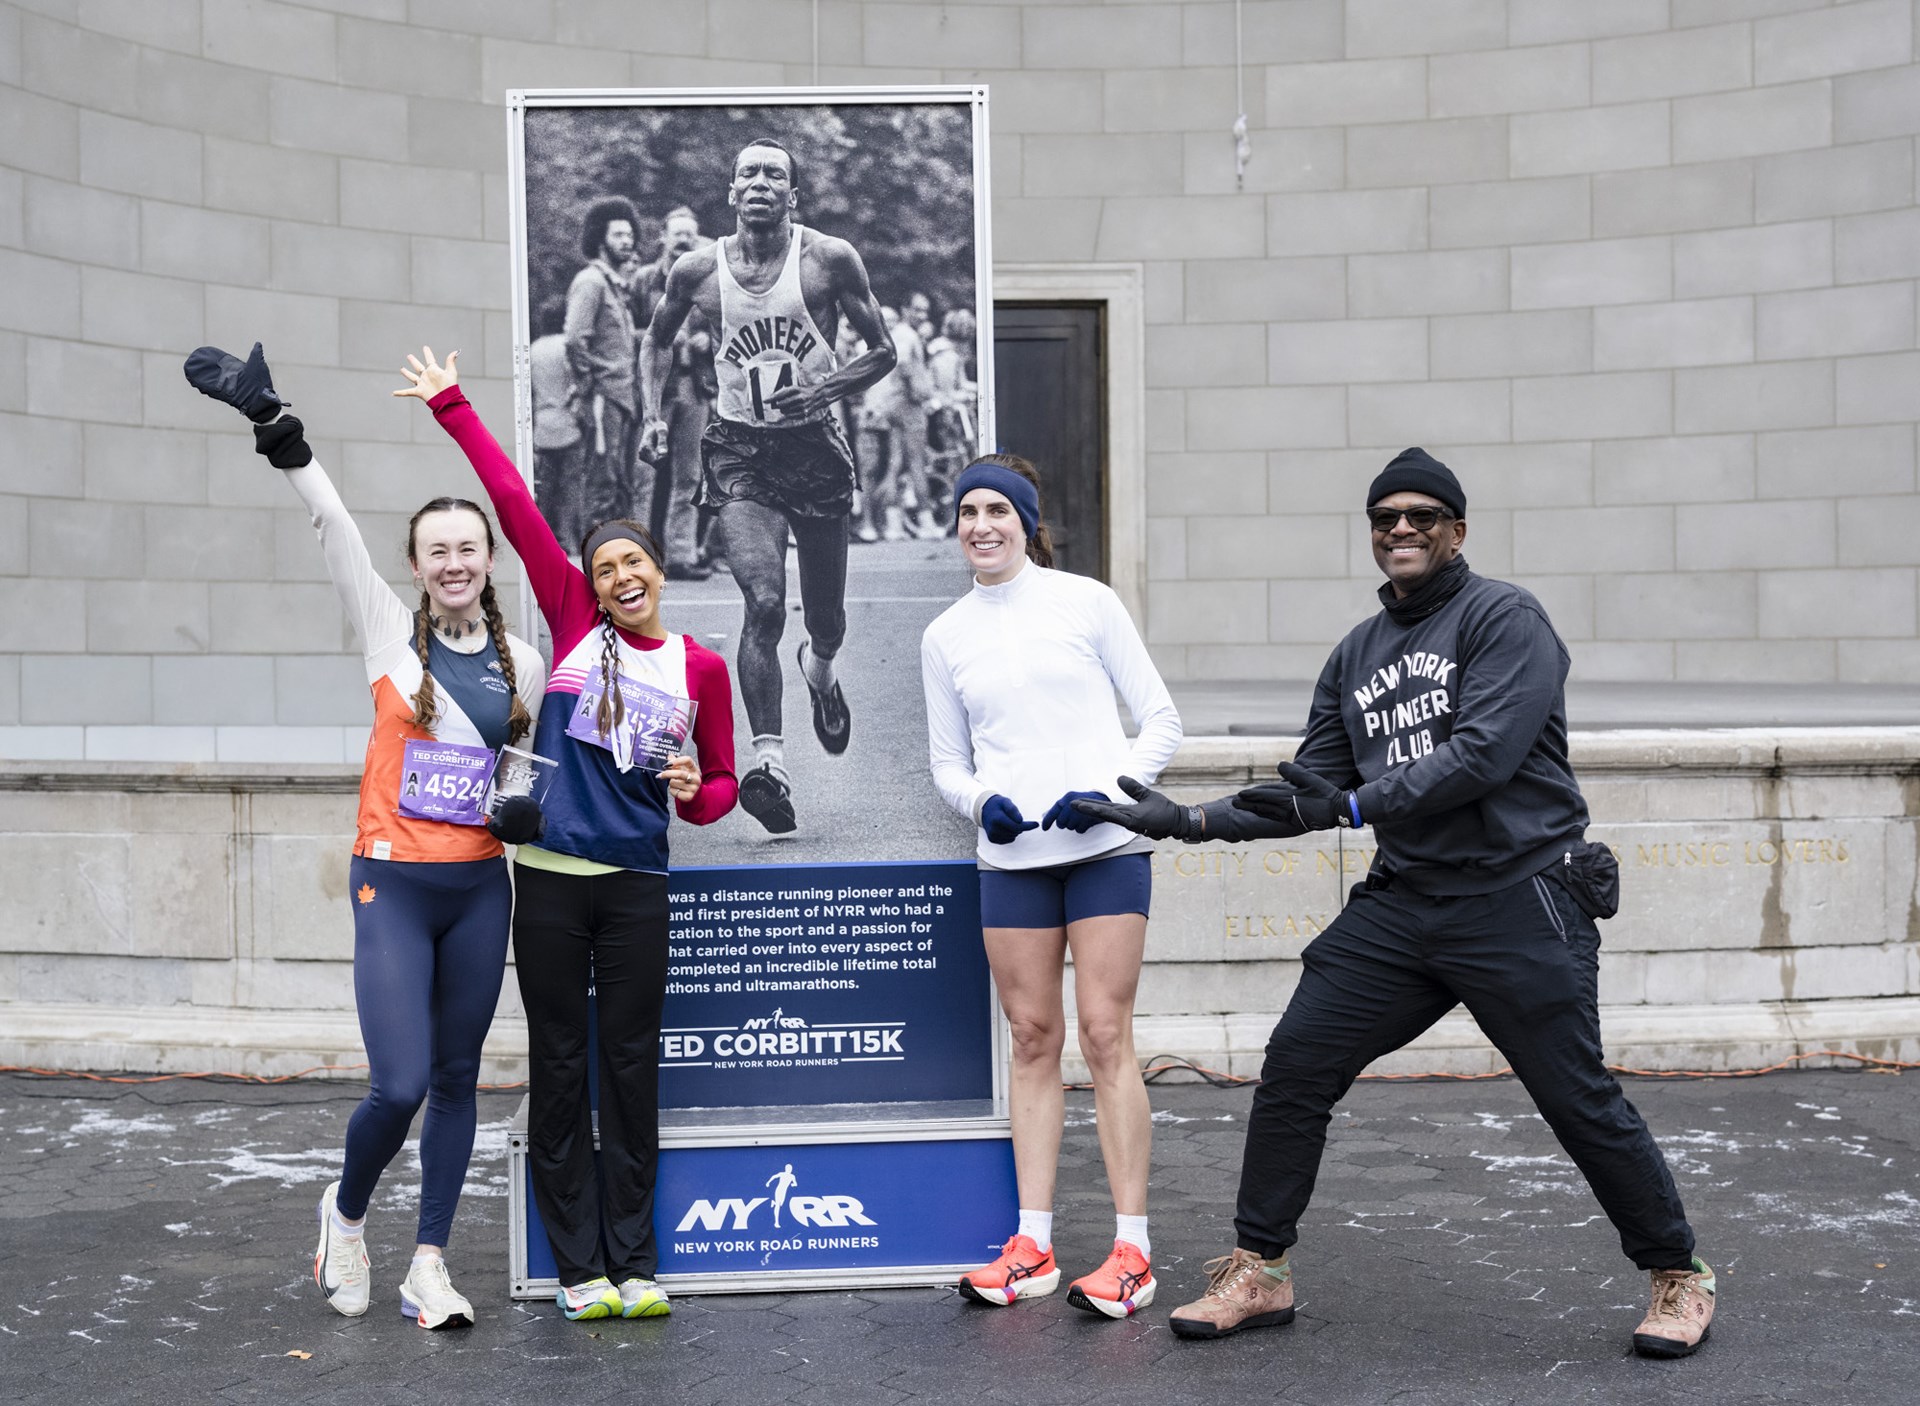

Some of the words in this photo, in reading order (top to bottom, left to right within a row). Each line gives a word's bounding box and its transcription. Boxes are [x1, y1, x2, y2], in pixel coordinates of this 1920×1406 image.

[723, 316, 816, 369] PIONEER
[1354, 660, 1402, 711] NEW
[1403, 652, 1458, 686] YORK
[413, 752, 431, 760] TED
[408, 772, 418, 785] A
[424, 773, 484, 802] 4524
[406, 784, 416, 797] A
[1636, 841, 1730, 868] MUSIC
[1744, 838, 1850, 866] LOVERS
[1174, 850, 1248, 877] CITY
[1263, 850, 1301, 876] OF
[667, 893, 696, 903] was
[699, 892, 709, 903] a
[712, 889, 774, 902] distance
[777, 887, 834, 902] running
[837, 886, 894, 901] pioneer
[897, 884, 925, 898] and
[928, 884, 953, 897] the
[697, 908, 727, 921] first
[730, 906, 800, 922] president
[803, 905, 820, 918] of
[823, 904, 866, 918] NYRR
[869, 903, 901, 917] who
[904, 902, 932, 916] had
[935, 905, 944, 915] a
[669, 926, 714, 940] cation
[717, 926, 734, 938] to
[736, 925, 761, 938] the
[765, 924, 804, 939] sport
[807, 922, 835, 936] and
[838, 925, 848, 935] a
[851, 921, 907, 937] passion
[910, 921, 932, 934] for
[1225, 914, 1327, 938] ELKAN
[668, 945, 692, 958] hat
[696, 943, 748, 957] carried
[751, 945, 785, 956] over
[788, 942, 817, 955] into
[820, 943, 861, 955] every
[864, 940, 914, 955] aspect
[917, 938, 933, 952] of
[744, 963, 762, 974] an
[766, 959, 839, 973] incredible
[843, 958, 899, 971] lifetime
[902, 956, 937, 970] total
[714, 979, 742, 993] and
[745, 977, 860, 992] ultramarathons.
[714, 1061, 737, 1069] NEW
[739, 1060, 764, 1069] YORK
[767, 1060, 793, 1068] ROAD
[795, 1058, 839, 1068] RUNNERS
[674, 1242, 710, 1254] NEW
[714, 1240, 755, 1252] YORK
[760, 1239, 803, 1251] ROAD
[808, 1237, 879, 1250] RUNNERS
